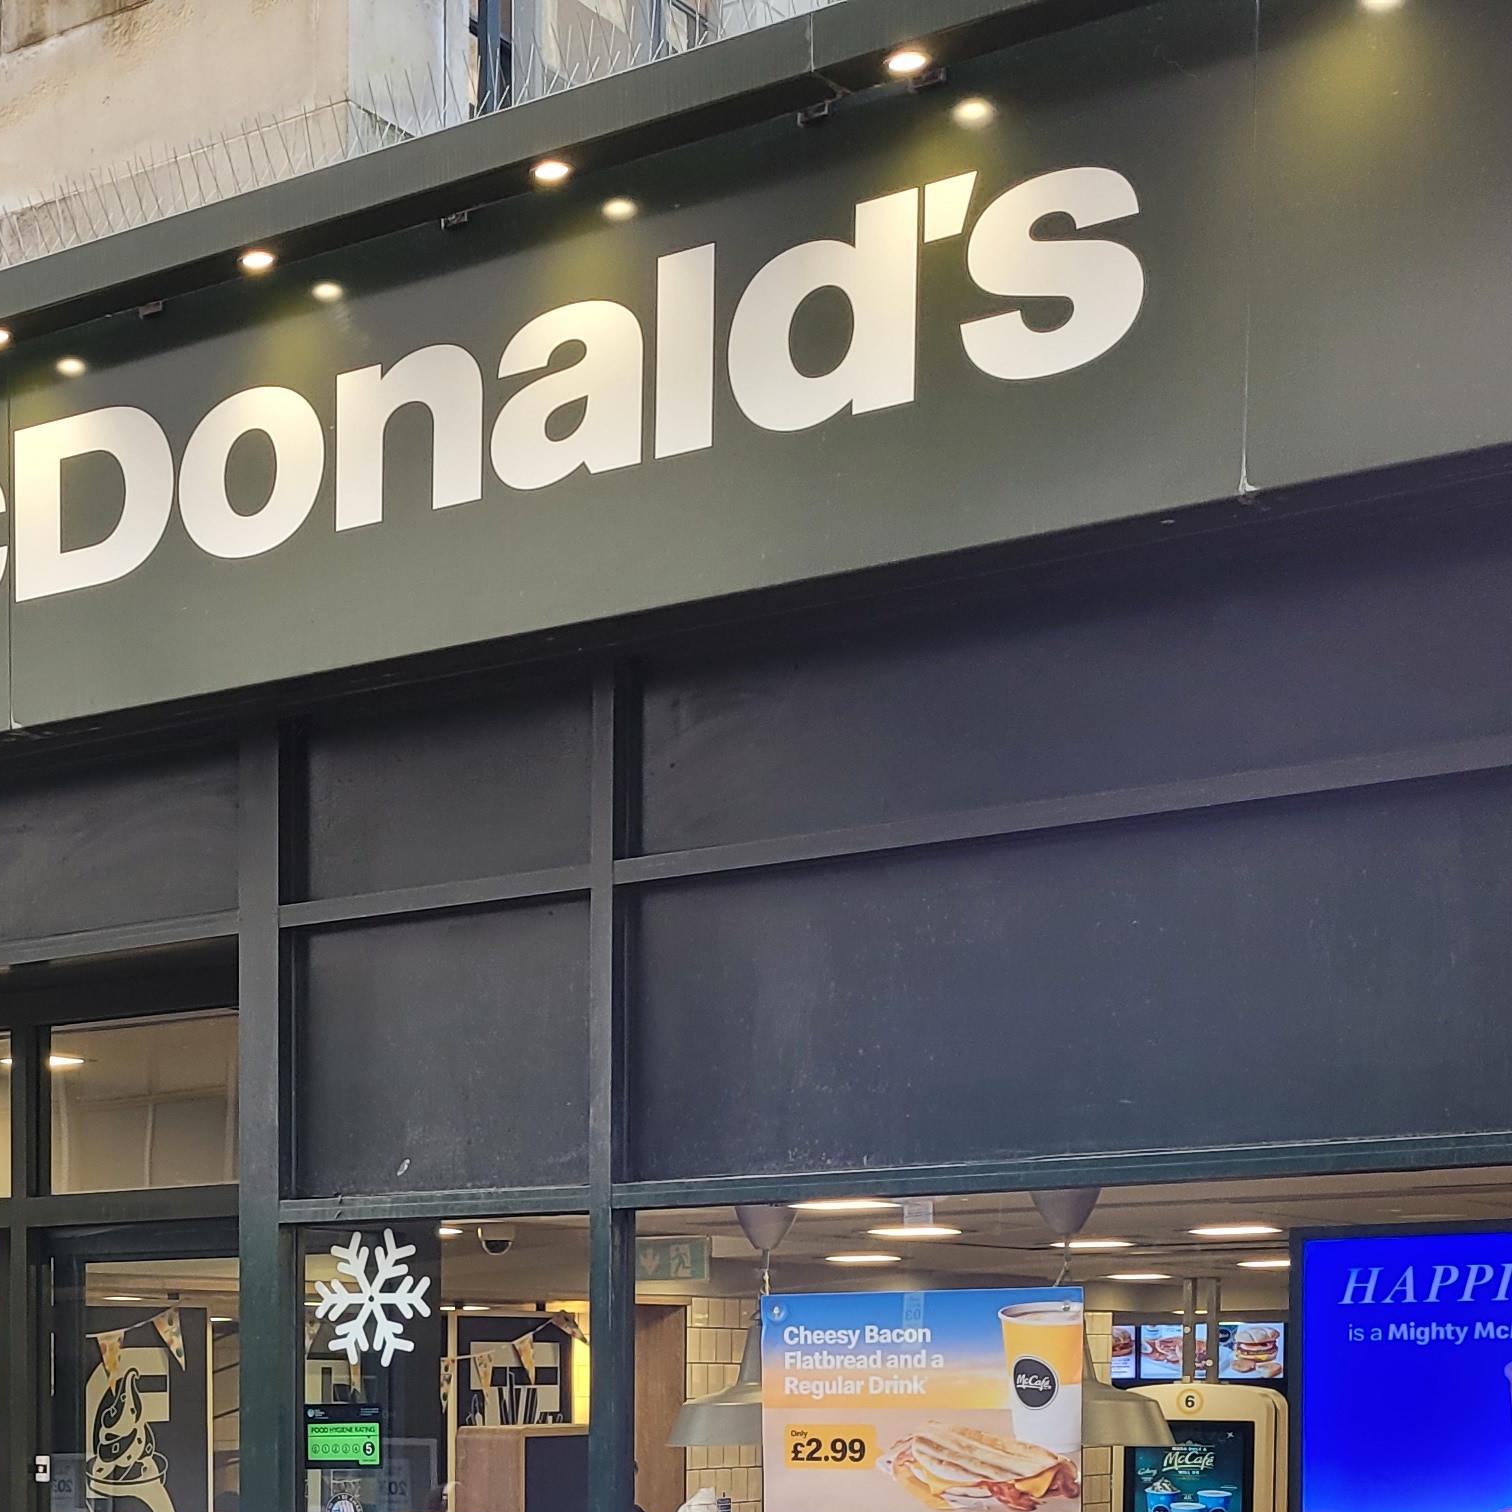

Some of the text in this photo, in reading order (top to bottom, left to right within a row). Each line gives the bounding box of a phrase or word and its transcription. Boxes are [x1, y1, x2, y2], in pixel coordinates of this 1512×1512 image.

[783, 1325, 931, 1349] Cheesy Bacon
[1349, 1322, 1512, 1345] is a Mighty Mc
[784, 1350, 944, 1370] Flatbread and a
[784, 1376, 864, 1400] Regular
[1185, 1396, 1195, 1408] 6
[791, 1430, 807, 1438] Only
[365, 1443, 372, 1454] 5
[791, 1438, 866, 1462] £2.99
